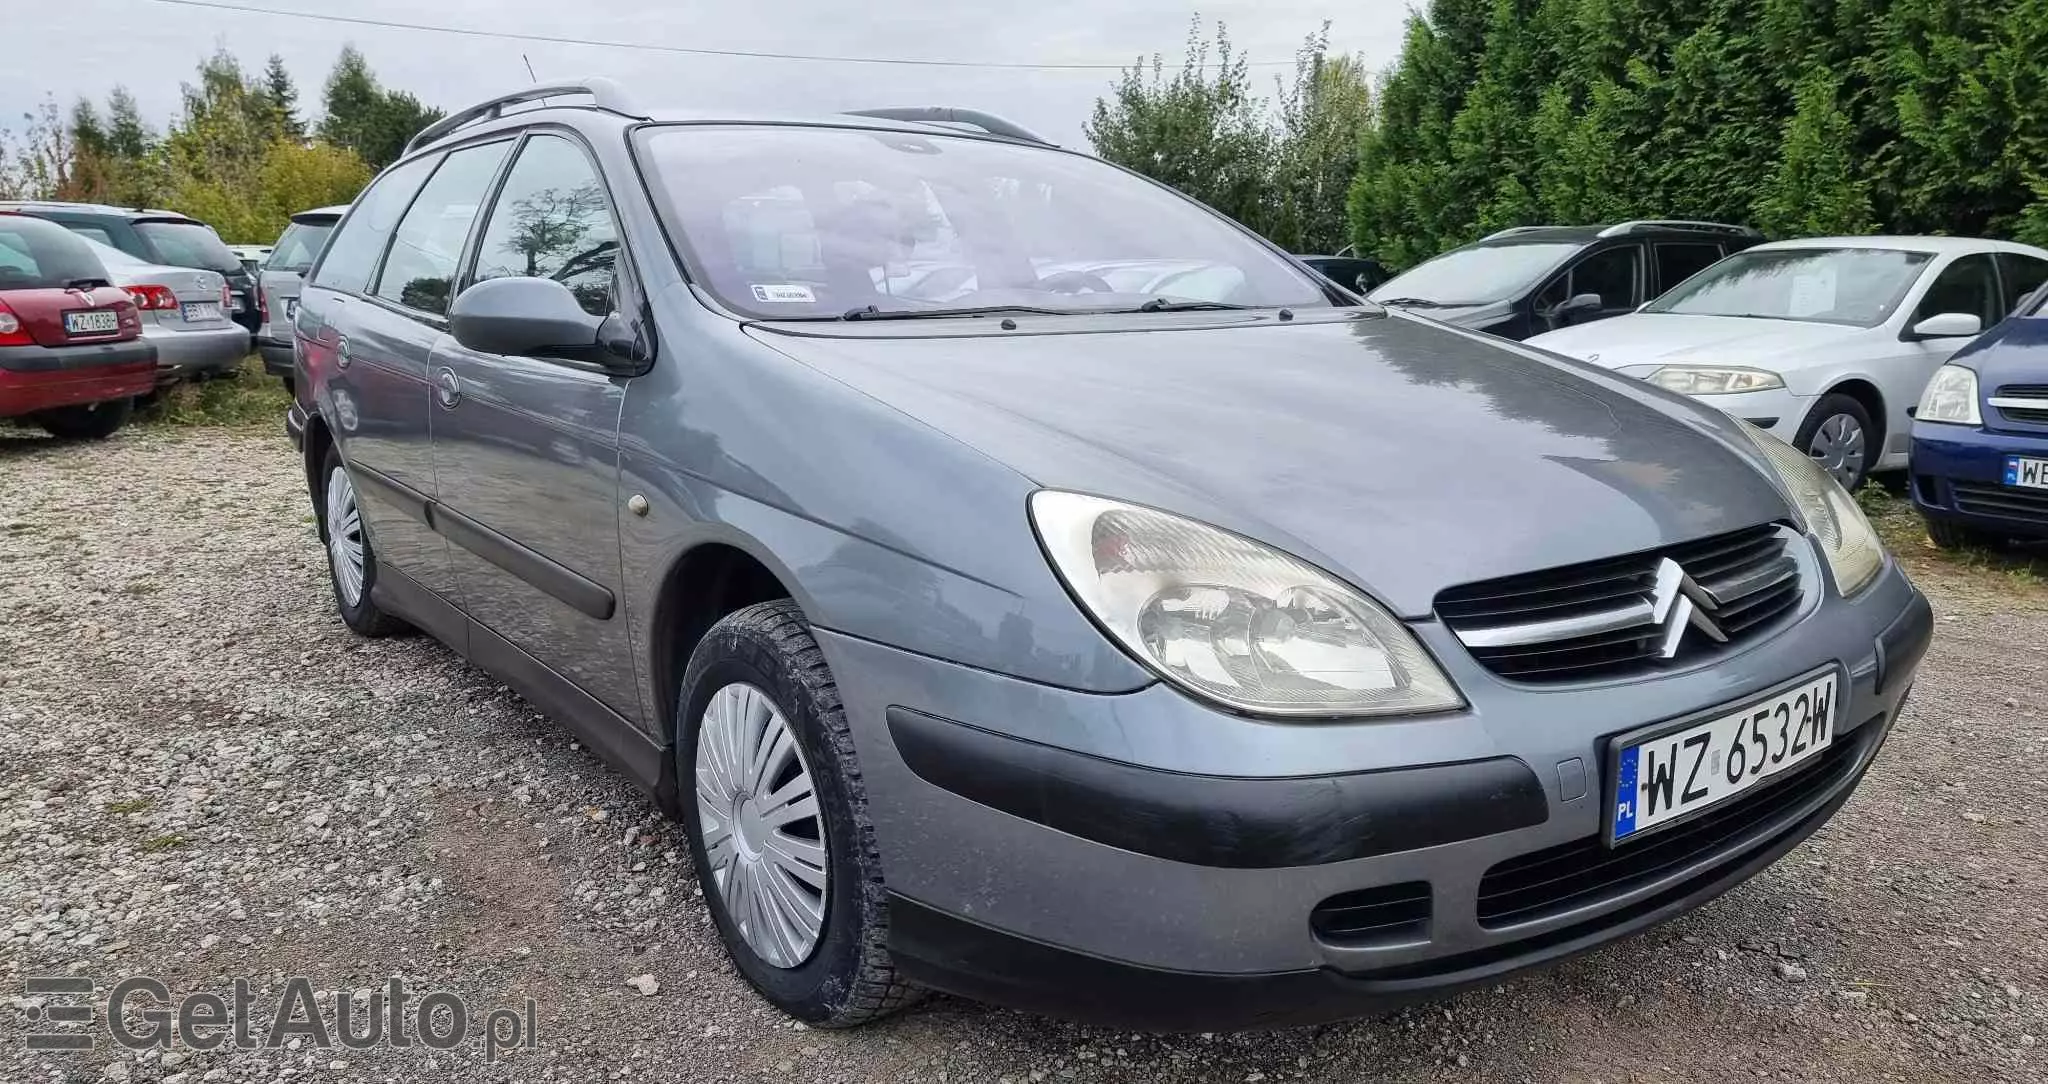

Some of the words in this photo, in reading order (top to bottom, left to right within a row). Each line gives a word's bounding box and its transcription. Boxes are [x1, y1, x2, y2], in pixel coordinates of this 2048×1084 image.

[71, 314, 87, 330] WZ
[1648, 731, 1711, 817] WZ
[1727, 681, 1832, 785] 6532W
[1617, 800, 1633, 821] PL
